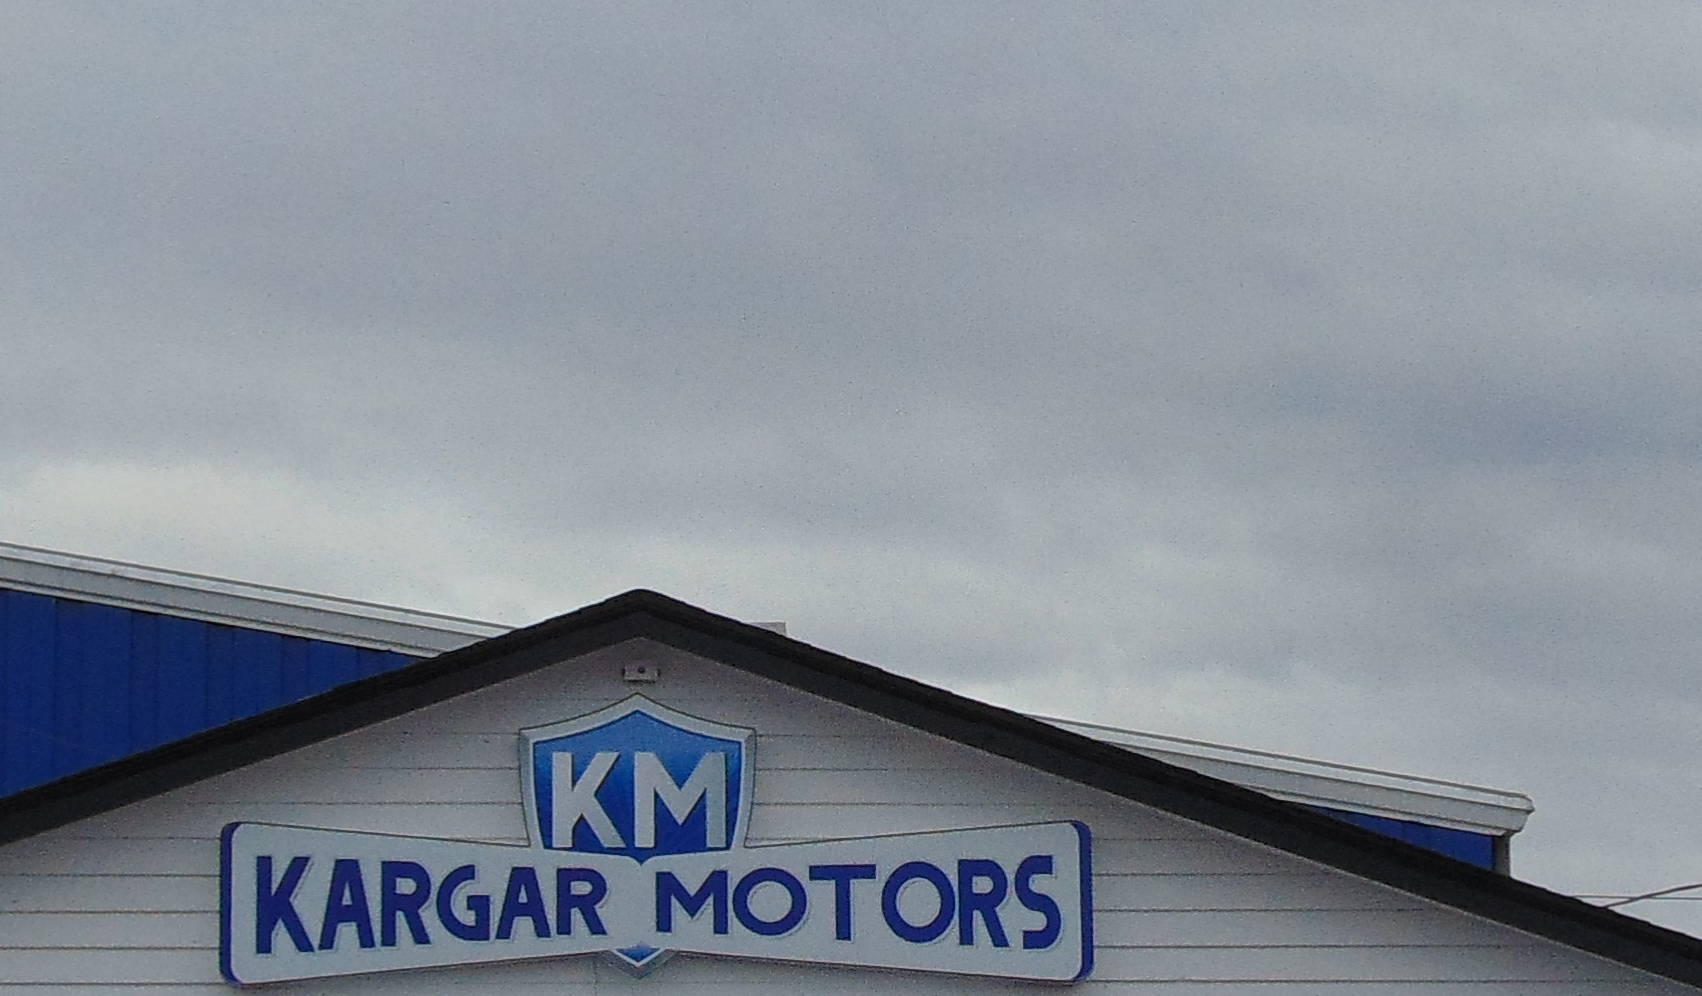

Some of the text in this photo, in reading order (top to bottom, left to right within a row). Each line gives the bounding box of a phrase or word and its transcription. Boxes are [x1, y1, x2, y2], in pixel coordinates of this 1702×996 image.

[551, 751, 728, 849] KM
[255, 854, 1063, 954] KARGAR MOTORS
